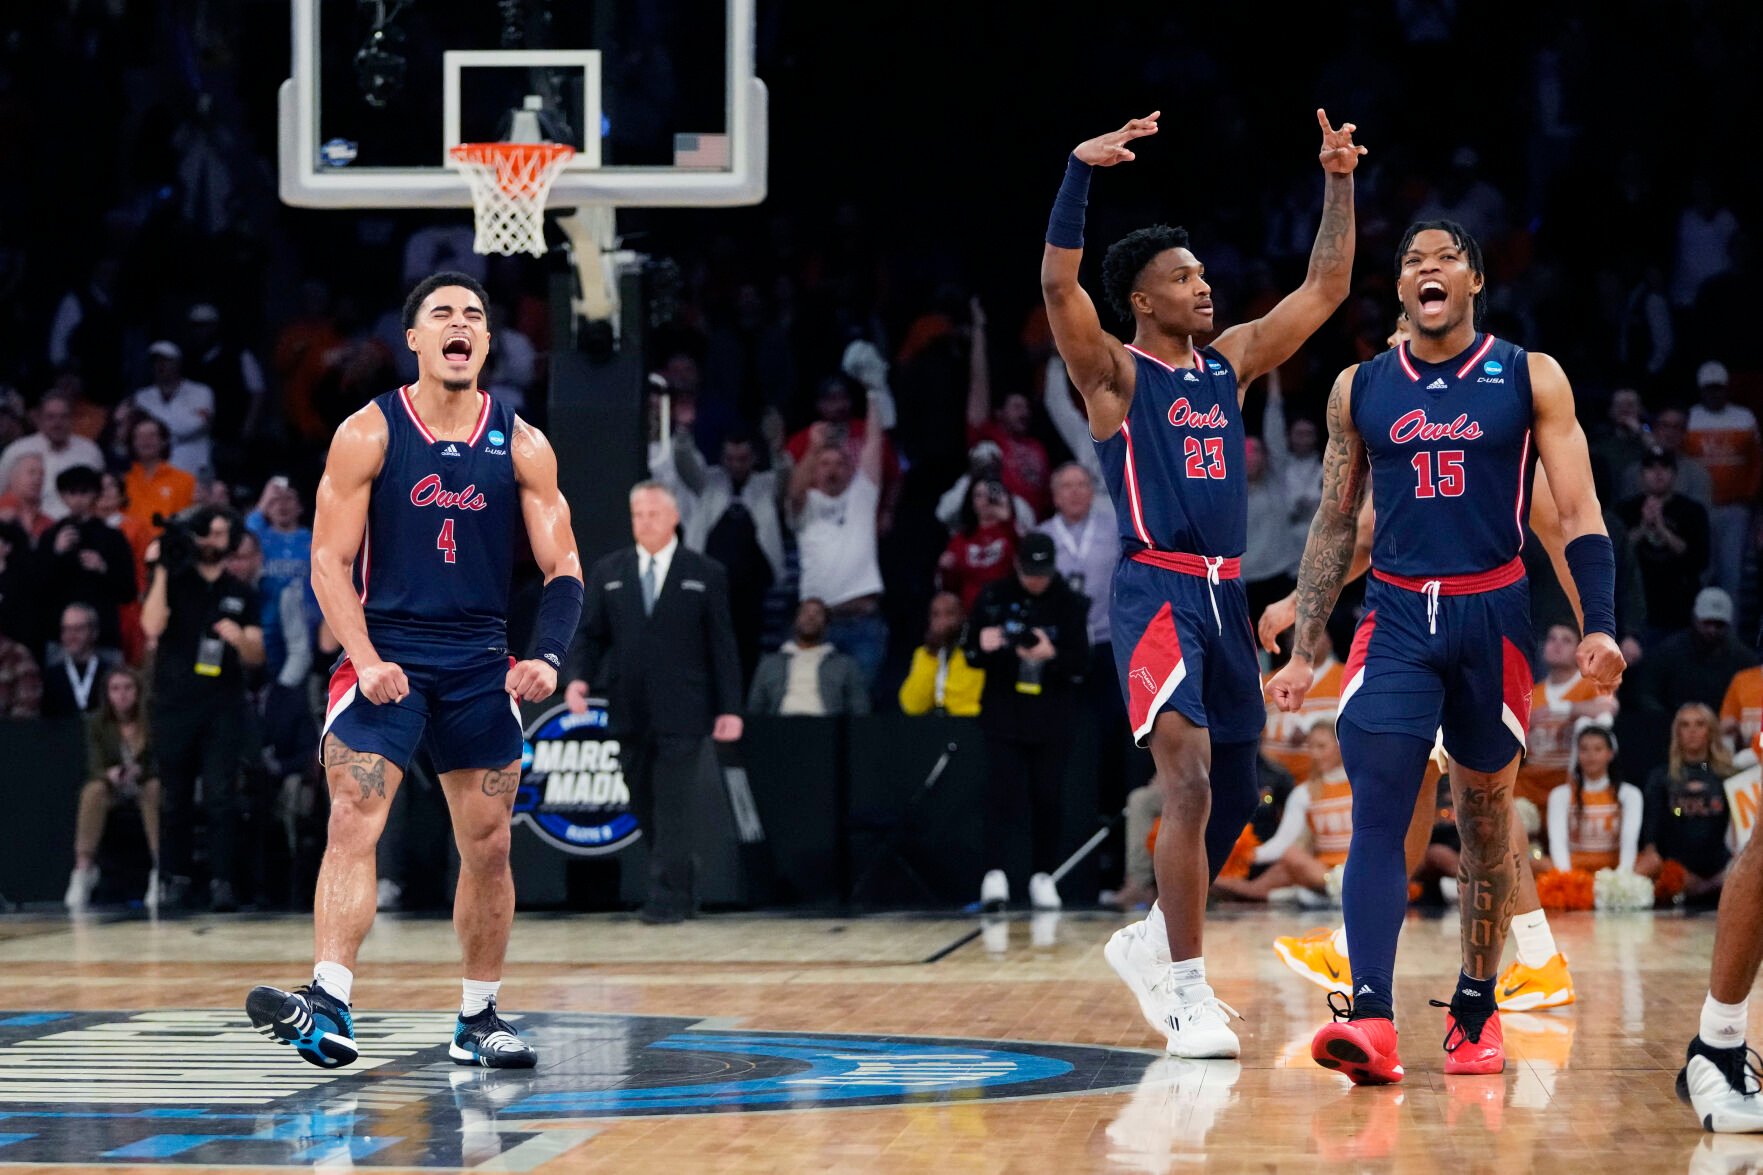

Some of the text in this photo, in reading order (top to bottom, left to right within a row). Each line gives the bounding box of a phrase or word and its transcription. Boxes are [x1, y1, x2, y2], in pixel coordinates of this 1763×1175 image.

[1168, 397, 1228, 429] Owls
[1390, 408, 1484, 444] Owls
[1184, 435, 1227, 480] 23
[1411, 450, 1466, 498] 15
[410, 473, 488, 511] Owls
[437, 518, 457, 564] 4
[532, 740, 622, 774] MARC
